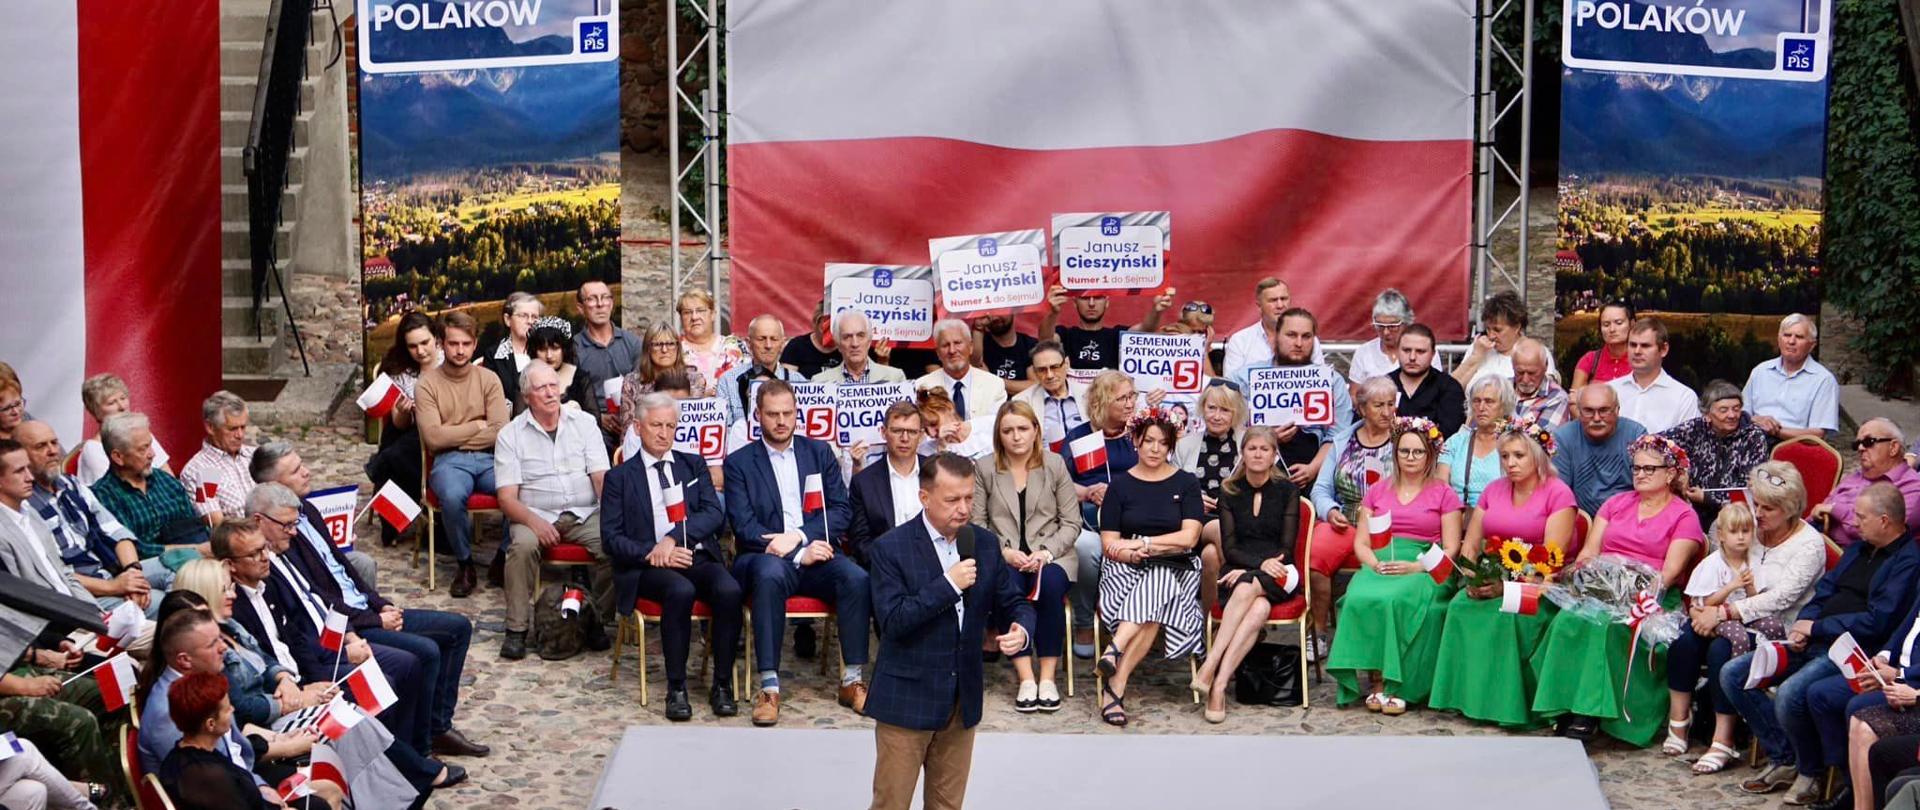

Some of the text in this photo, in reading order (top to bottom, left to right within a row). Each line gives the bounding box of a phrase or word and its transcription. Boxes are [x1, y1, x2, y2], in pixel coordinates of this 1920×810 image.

[1577, 0, 1745, 36] POLAKÓW
[1084, 241, 1139, 253] Janusz
[963, 261, 1018, 275] Janusz
[1066, 254, 1157, 272] Cieszyński
[948, 271, 1037, 291] Cieszyński
[1102, 275, 1109, 283] 1
[1125, 275, 1156, 285] Sejmu!
[855, 292, 910, 305] Janusz
[951, 298, 982, 306] Numer
[986, 296, 992, 304] 1
[1008, 291, 1038, 301] Sejmu!
[1129, 336, 1191, 347] SEMENIUK
[1125, 347, 1200, 357] PATKOWSKA
[1123, 358, 1172, 375] OLGA
[1176, 363, 1196, 387] 5
[1258, 369, 1320, 380] SEMENIUK
[840, 386, 901, 398] SEMENIUK
[1254, 380, 1330, 390] PATKOWSKA
[1253, 392, 1302, 409] OLGA
[1307, 393, 1326, 419] 5
[809, 410, 829, 436] 5
[838, 410, 885, 428] OLGA
[702, 427, 721, 454] 5
